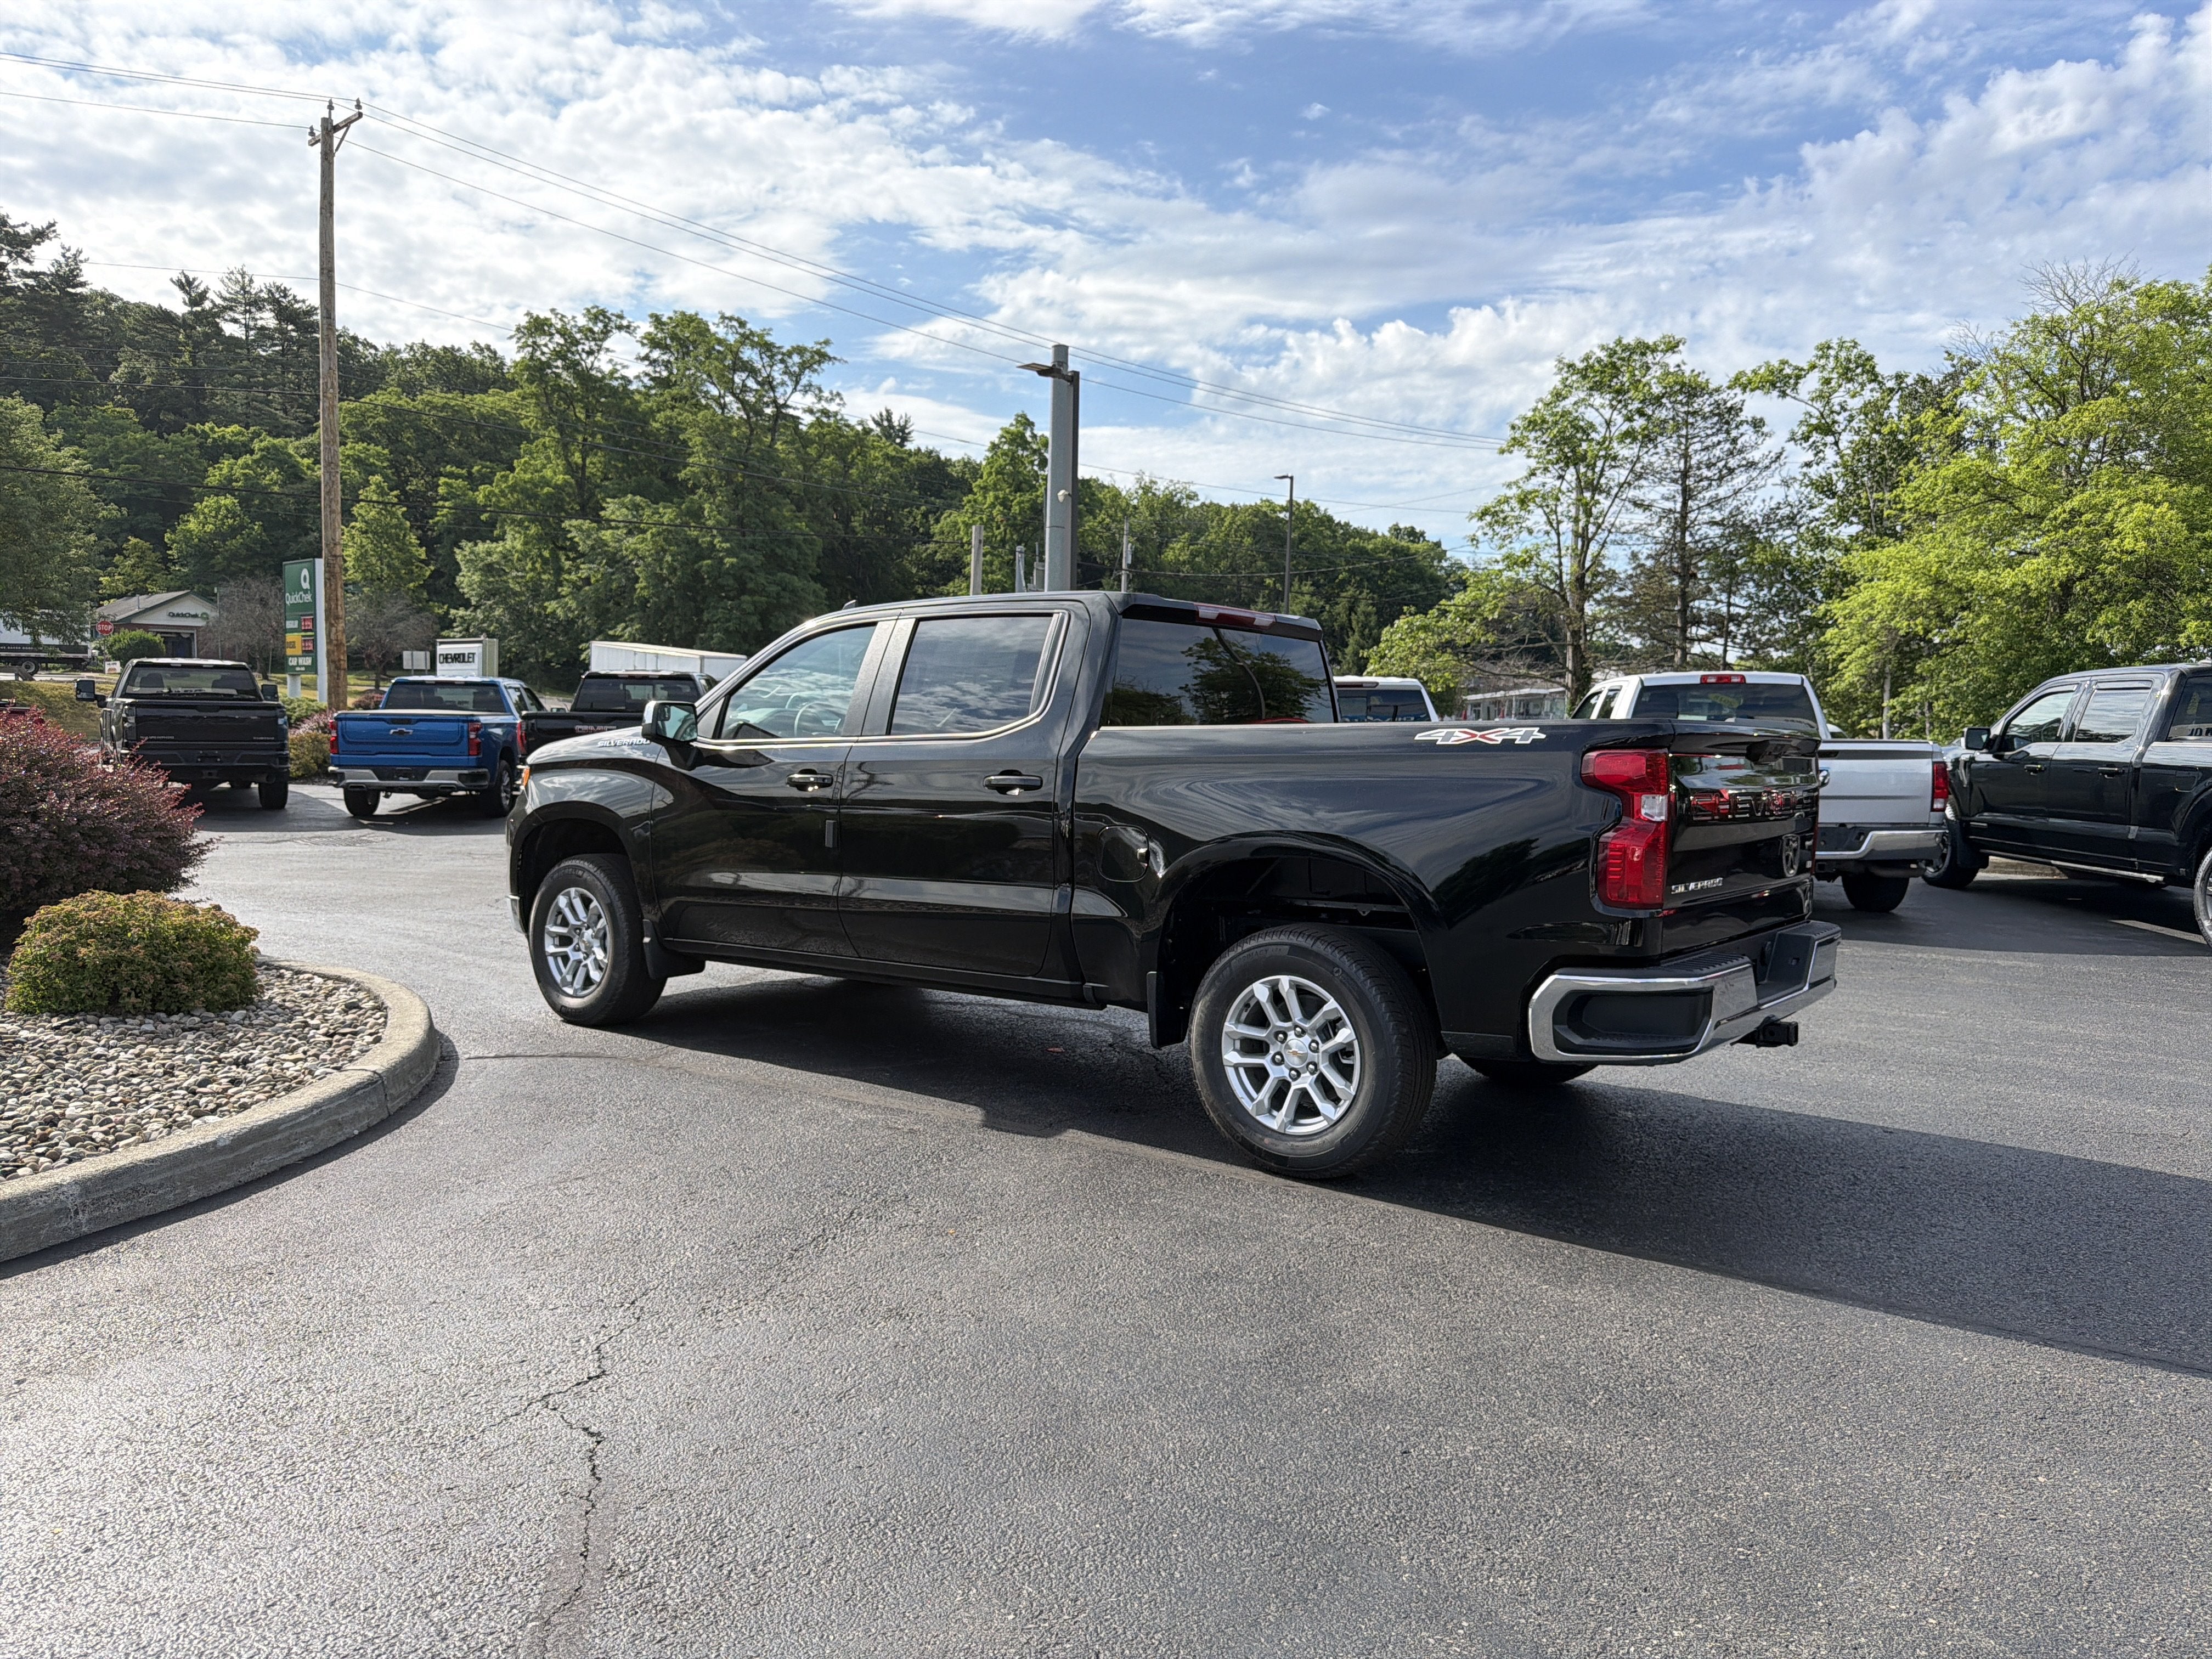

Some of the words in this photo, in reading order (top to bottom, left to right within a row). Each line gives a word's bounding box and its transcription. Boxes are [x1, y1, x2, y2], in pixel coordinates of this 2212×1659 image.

[285, 591, 313, 606] QuickChek
[288, 657, 297, 666] CAR
[298, 657, 312, 665] WASH
[439, 652, 476, 664] CHEVROLET
[1671, 877, 1724, 894] SILVERADO
